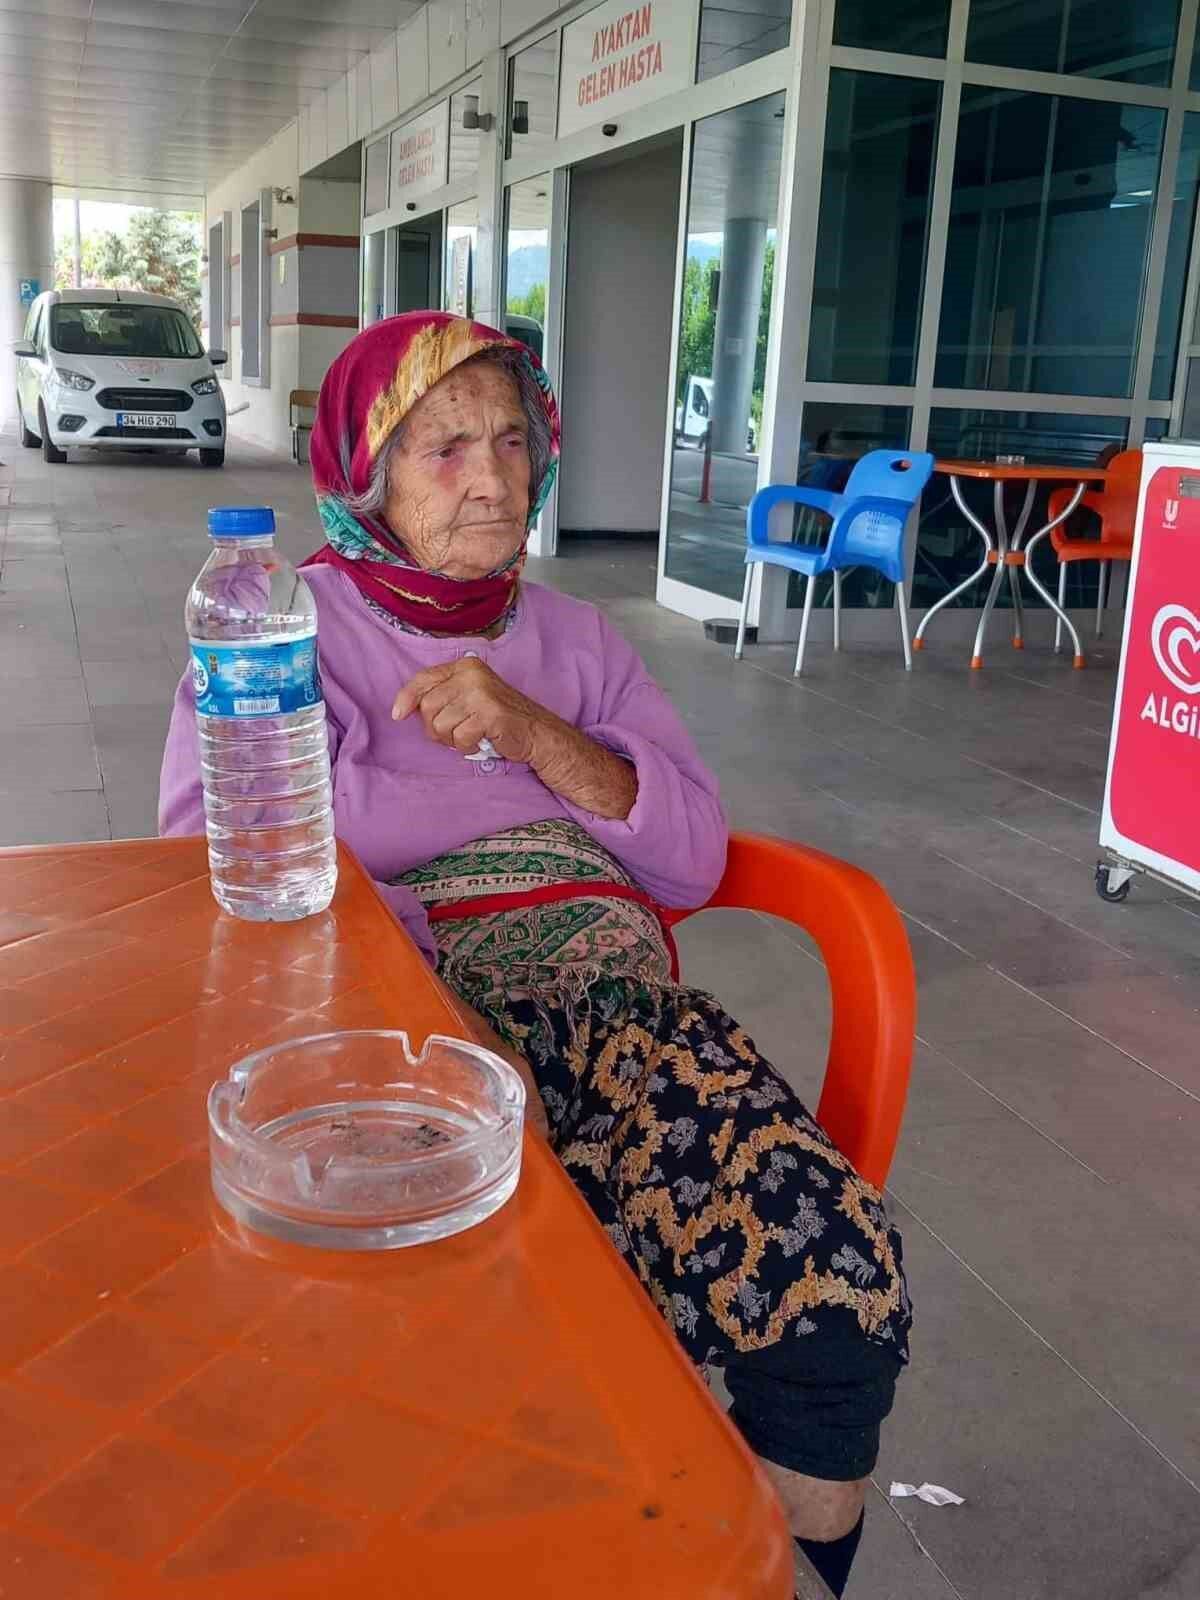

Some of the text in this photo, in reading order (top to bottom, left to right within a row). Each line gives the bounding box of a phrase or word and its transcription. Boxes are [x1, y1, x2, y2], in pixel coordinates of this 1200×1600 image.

[592, 2, 652, 63] AYAKTAN
[577, 41, 662, 107] GELEN HASTA
[123, 415, 174, 426] 34 HIG 290
